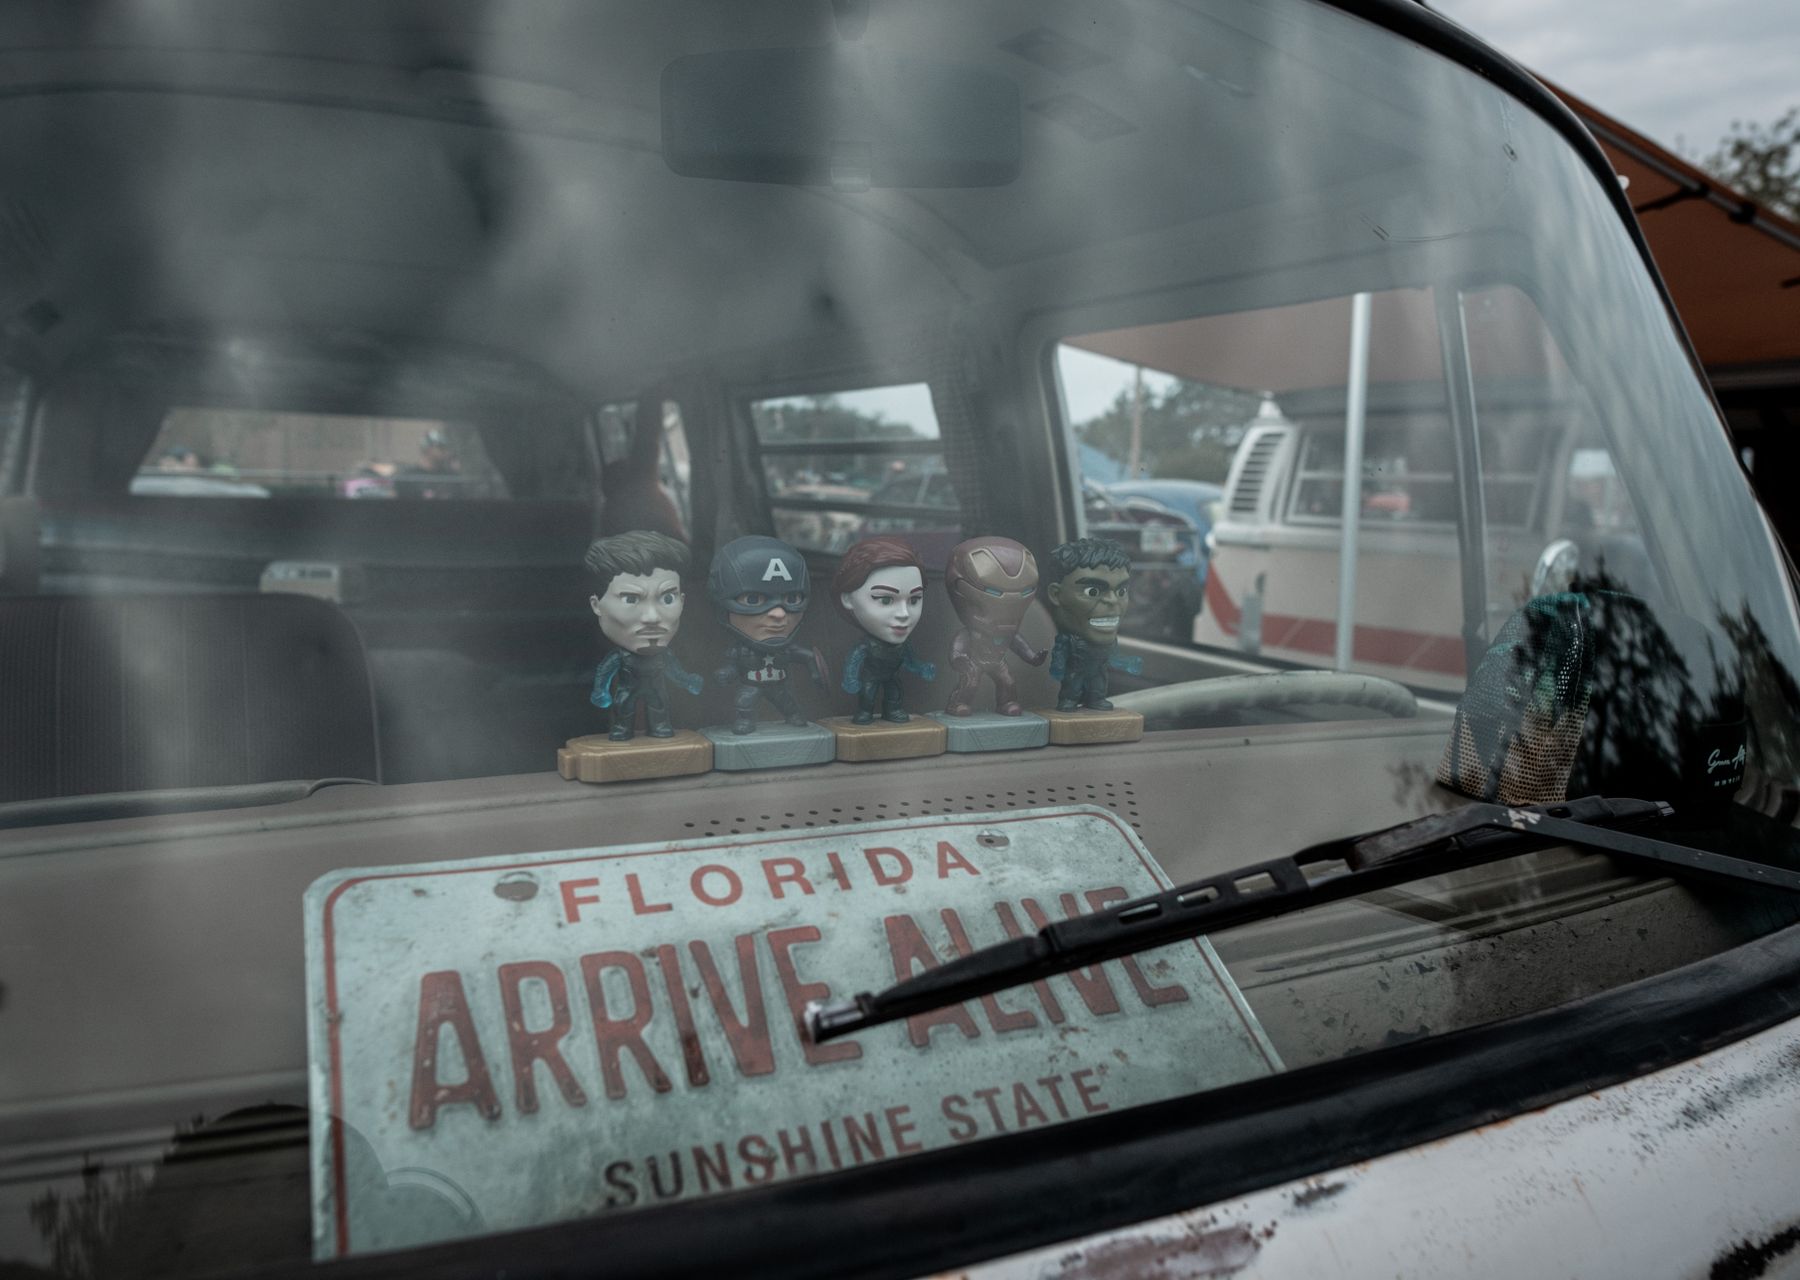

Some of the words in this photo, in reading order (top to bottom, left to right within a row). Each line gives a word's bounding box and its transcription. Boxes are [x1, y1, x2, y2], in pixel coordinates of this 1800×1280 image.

[761, 558, 793, 581] A
[559, 841, 980, 924] FLORIDA
[409, 925, 864, 1130] ARRIVE
[884, 886, 1190, 1048] ALIVE
[604, 1105, 923, 1207] SUNSHINE
[941, 1069, 1110, 1142] STATE
